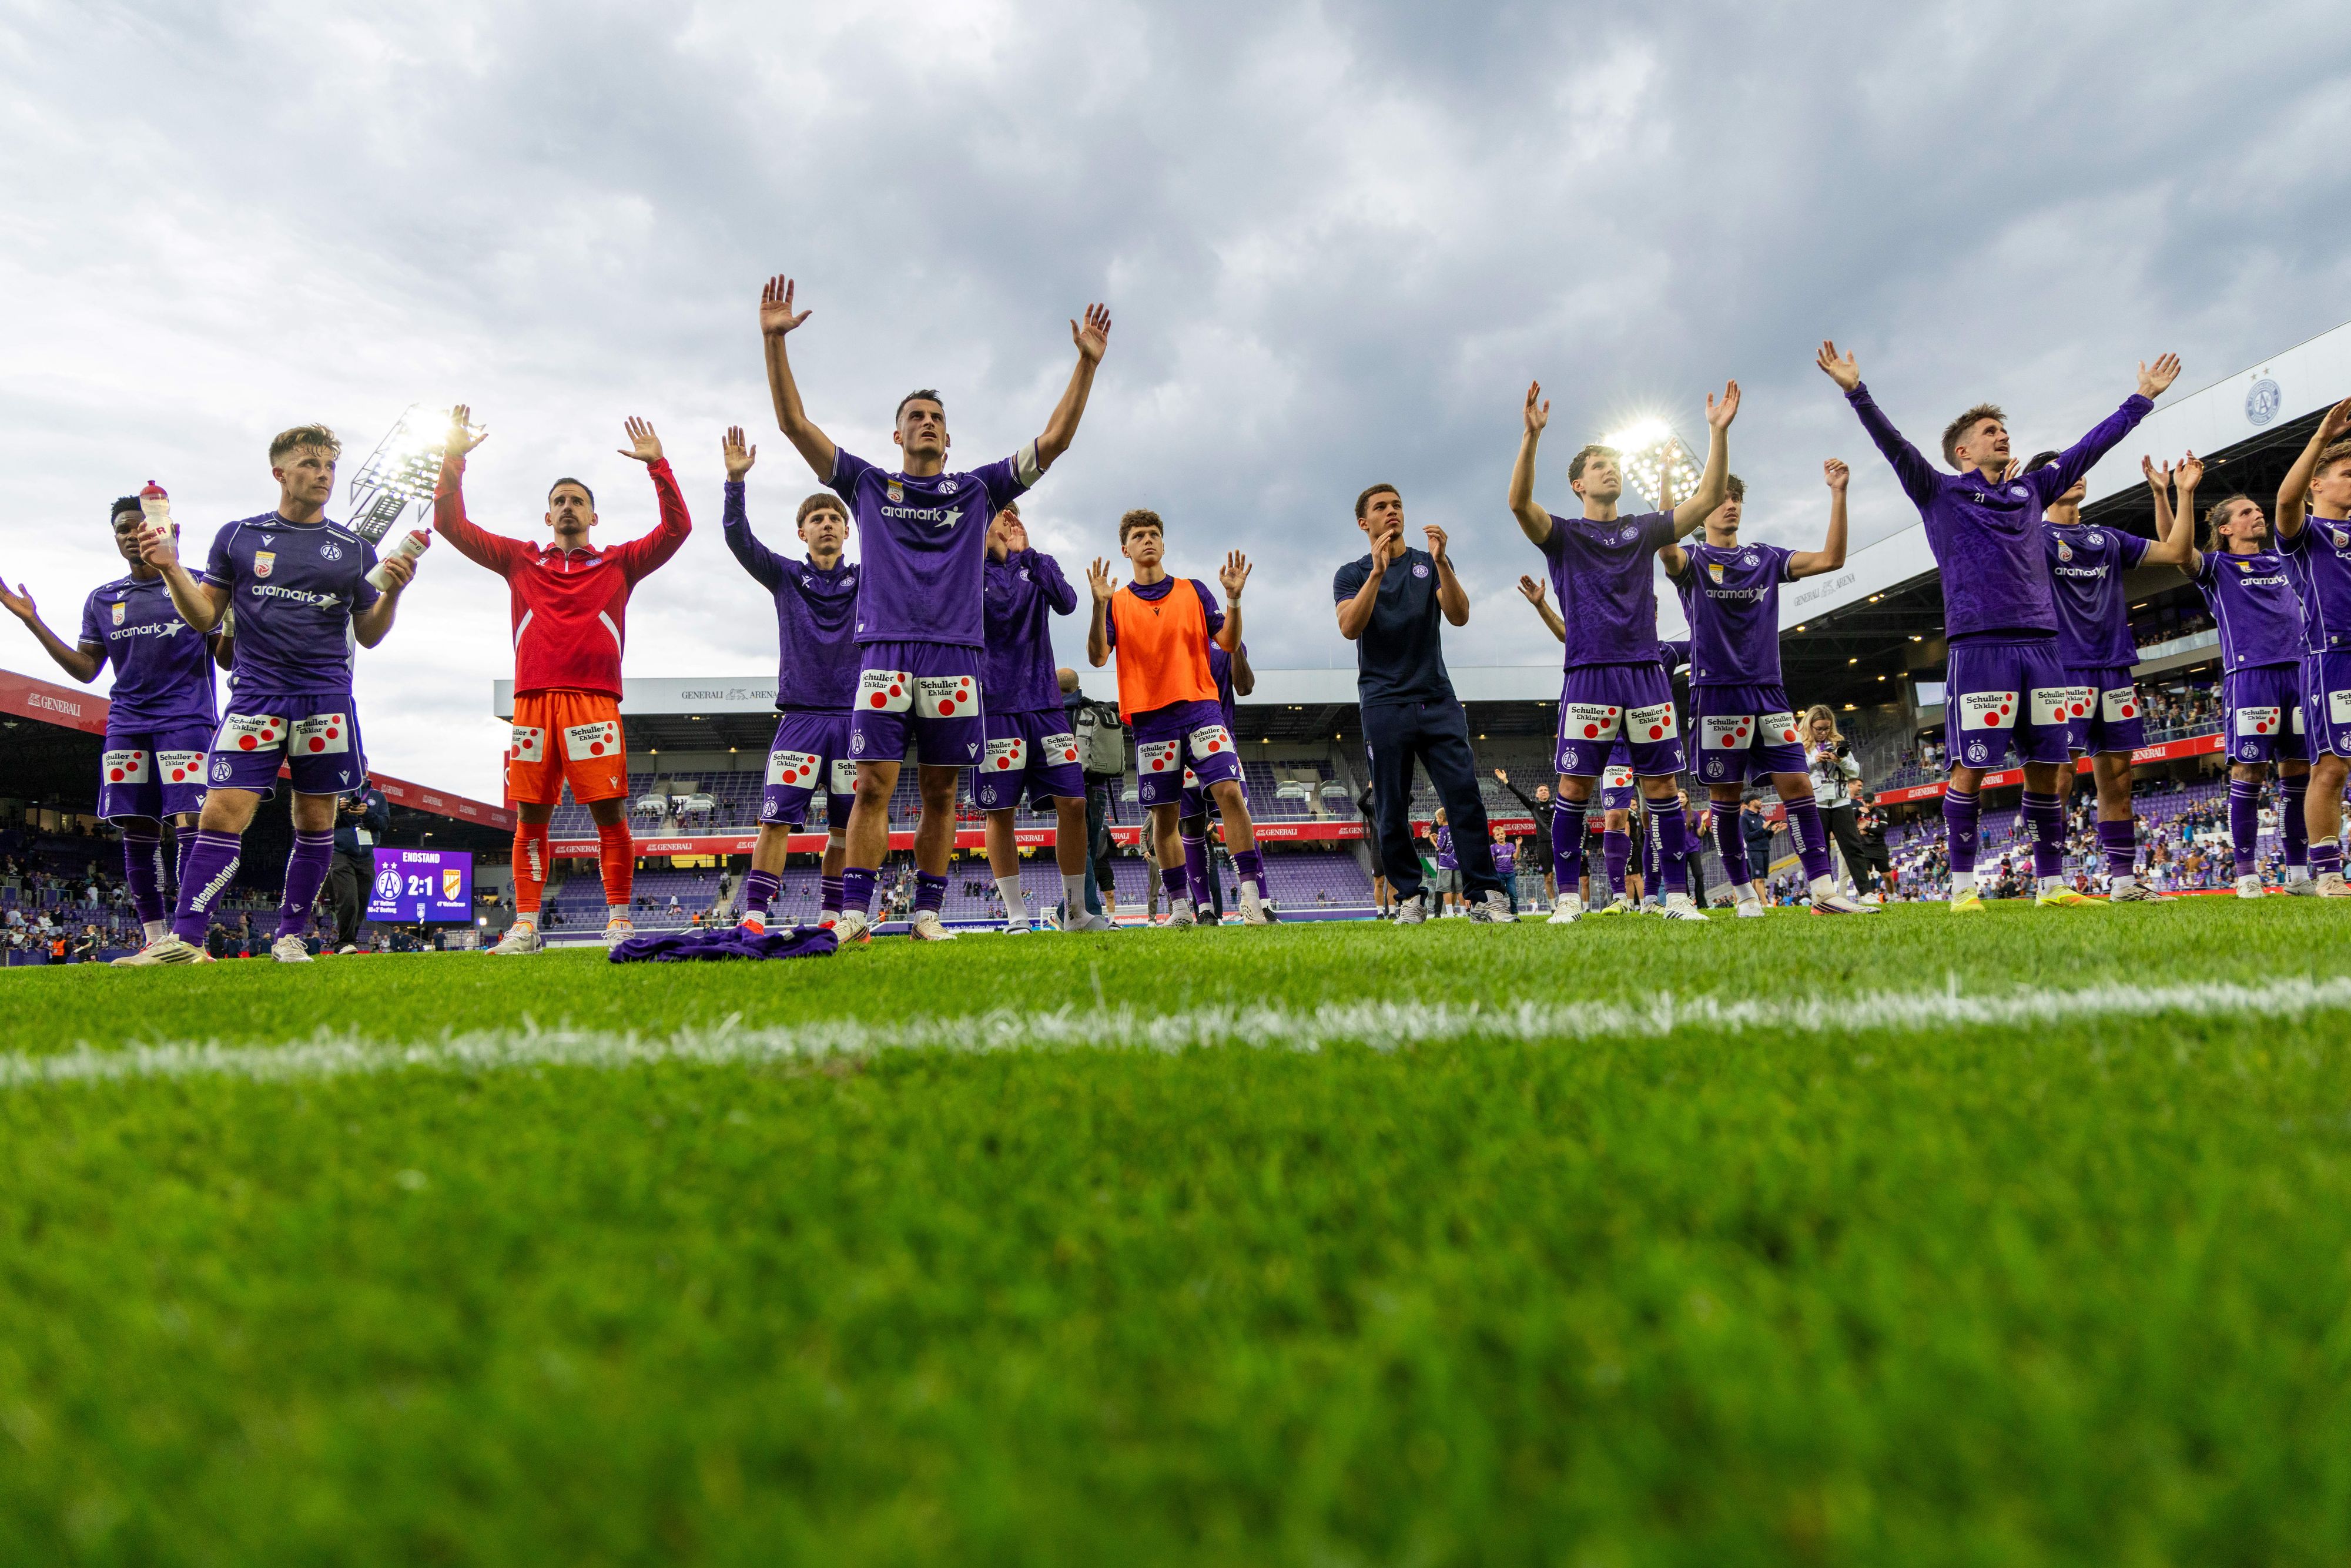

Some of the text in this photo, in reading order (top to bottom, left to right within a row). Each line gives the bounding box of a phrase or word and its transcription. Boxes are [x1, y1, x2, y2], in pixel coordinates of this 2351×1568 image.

[1974, 493, 1985, 502] 21
[881, 506, 942, 521] aramark
[324, 546, 339, 559] FAK
[2055, 567, 2101, 576] aramark
[2241, 575, 2283, 586] aramark
[252, 585, 316, 602] aramark
[1706, 588, 1754, 598] aramark
[1794, 573, 1856, 607] GENERALI ARENA
[110, 623, 161, 640] aramark
[749, 691, 778, 699] ARENA
[1967, 695, 2002, 703] Schuller
[41, 696, 81, 716] GENERALI
[1571, 706, 1605, 715] Schuller
[1632, 709, 1663, 719] Schuller
[1765, 716, 1792, 725] Schuller
[571, 726, 604, 736] Schuller
[1194, 728, 1220, 739] Schuller
[1047, 736, 1073, 745] Schuller
[1140, 745, 1166, 753] Schuller
[1971, 746, 1985, 760] FAK
[2245, 746, 2256, 758] FAK
[773, 754, 804, 762] Schuller
[1564, 753, 1576, 767] FAK
[215, 763, 228, 780] FAK
[1709, 763, 1722, 776] FAK
[1915, 785, 1938, 796] GENERALI
[984, 790, 994, 803] FAK
[765, 802, 775, 815] FAK
[1788, 815, 1806, 854] wienholdi
[566, 845, 600, 853] GENERAL
[403, 852, 440, 863] ENDSTAND
[190, 856, 240, 912] wienholding
[381, 873, 398, 897] FAK
[408, 875, 433, 896] 2:1
